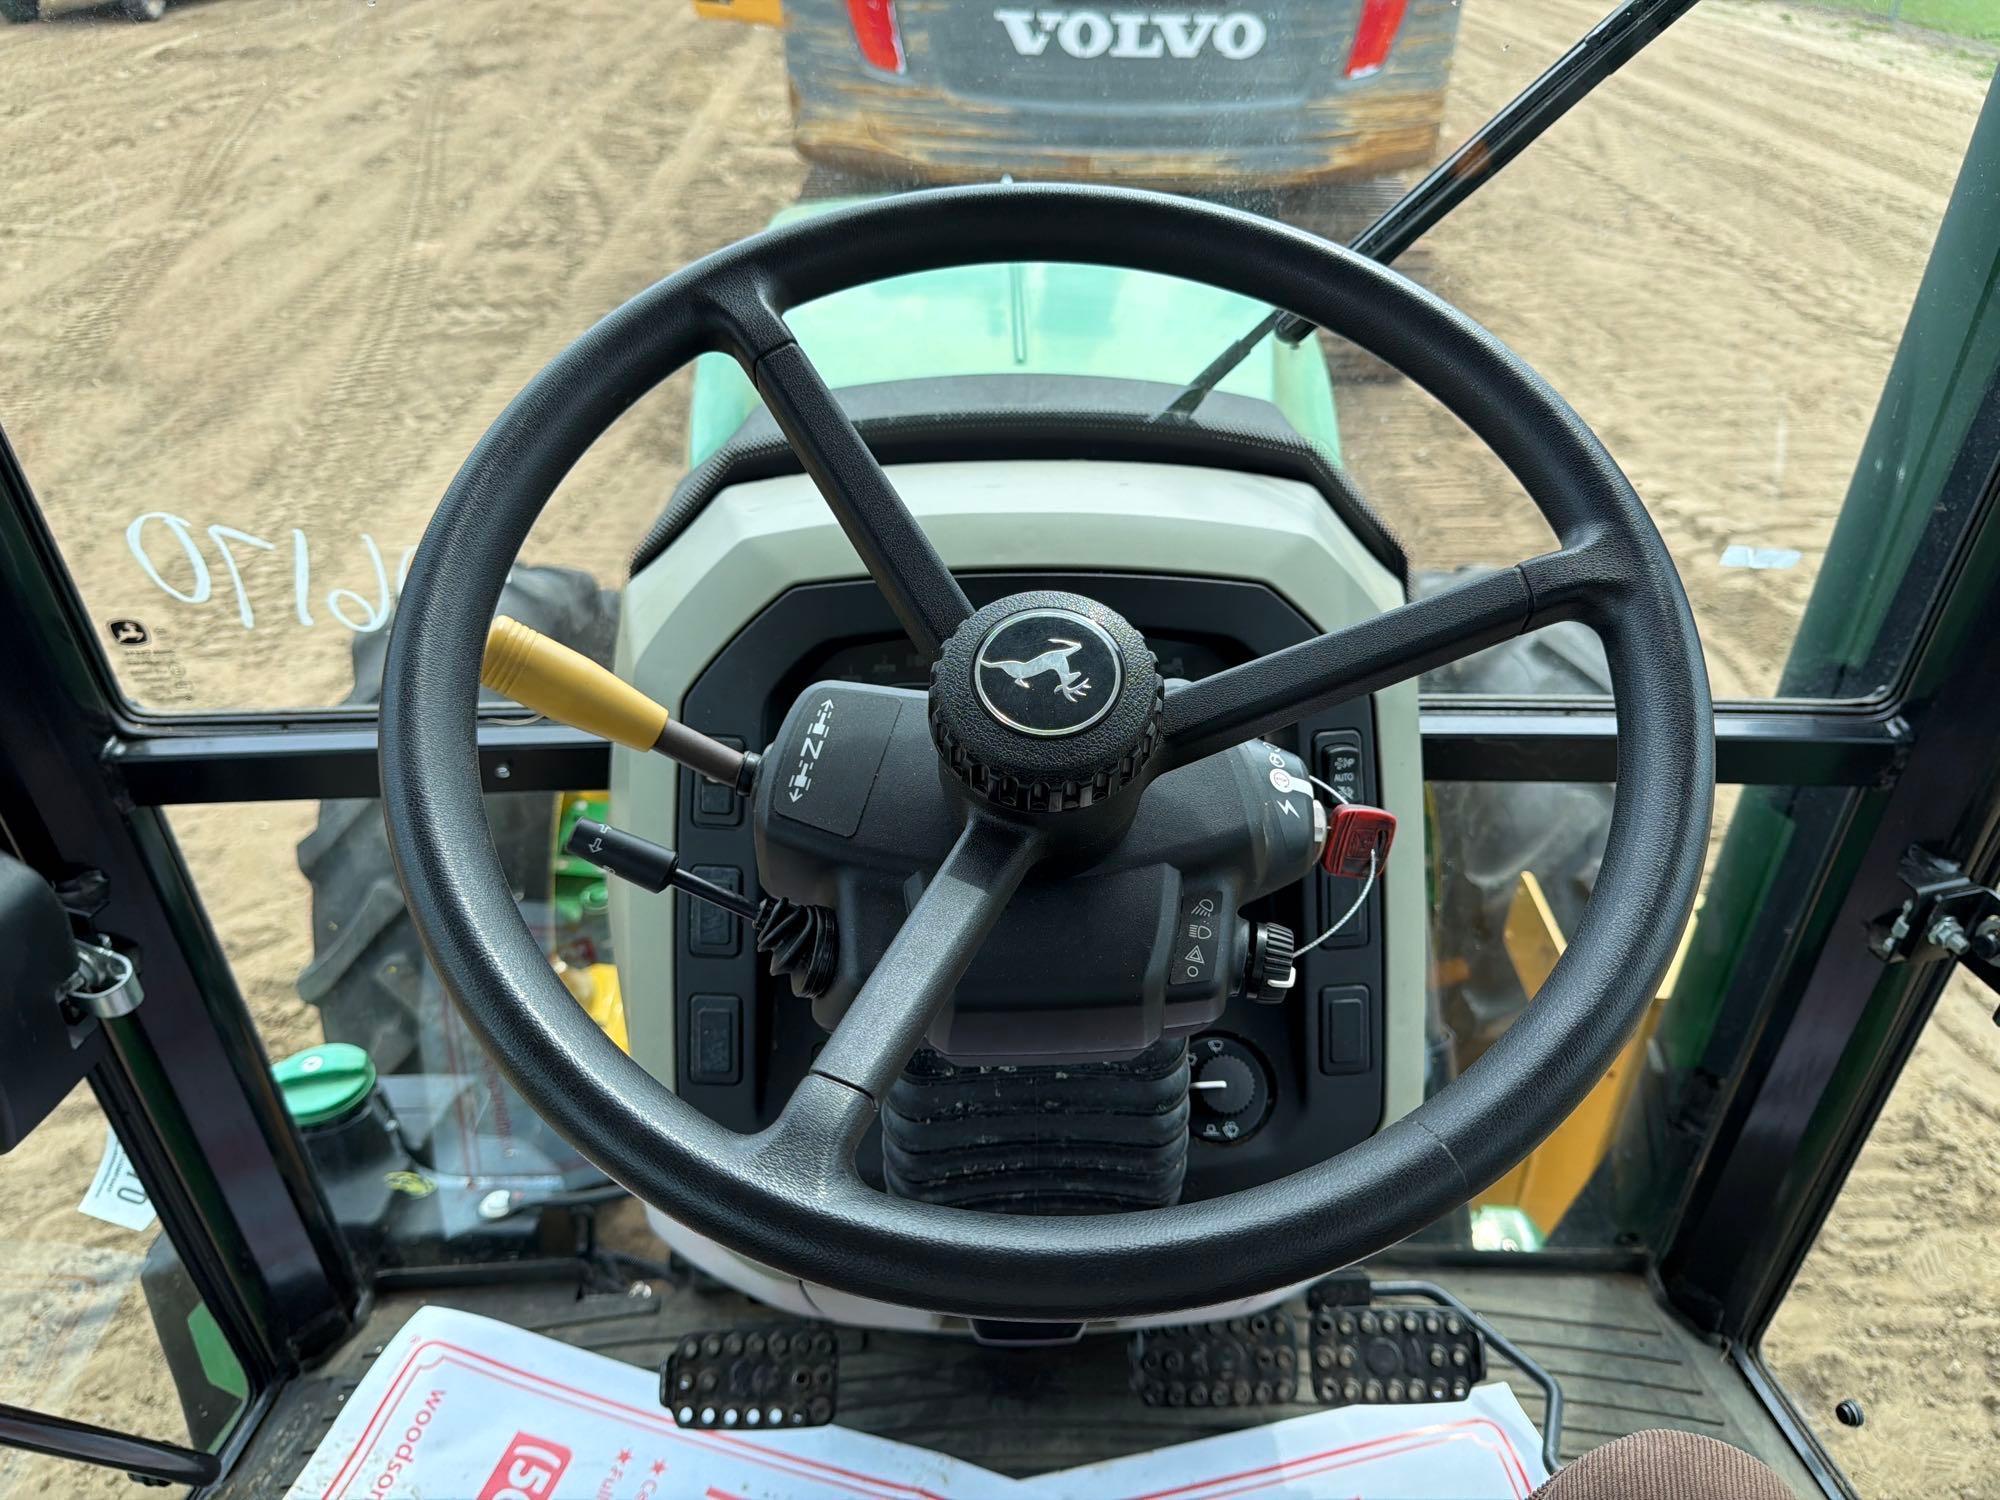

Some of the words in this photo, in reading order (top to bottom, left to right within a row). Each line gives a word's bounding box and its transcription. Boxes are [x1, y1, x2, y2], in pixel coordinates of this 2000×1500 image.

[993, 8, 1267, 60] VOLVO
[800, 737, 824, 760] N
[1333, 772, 1354, 782] AUTO
